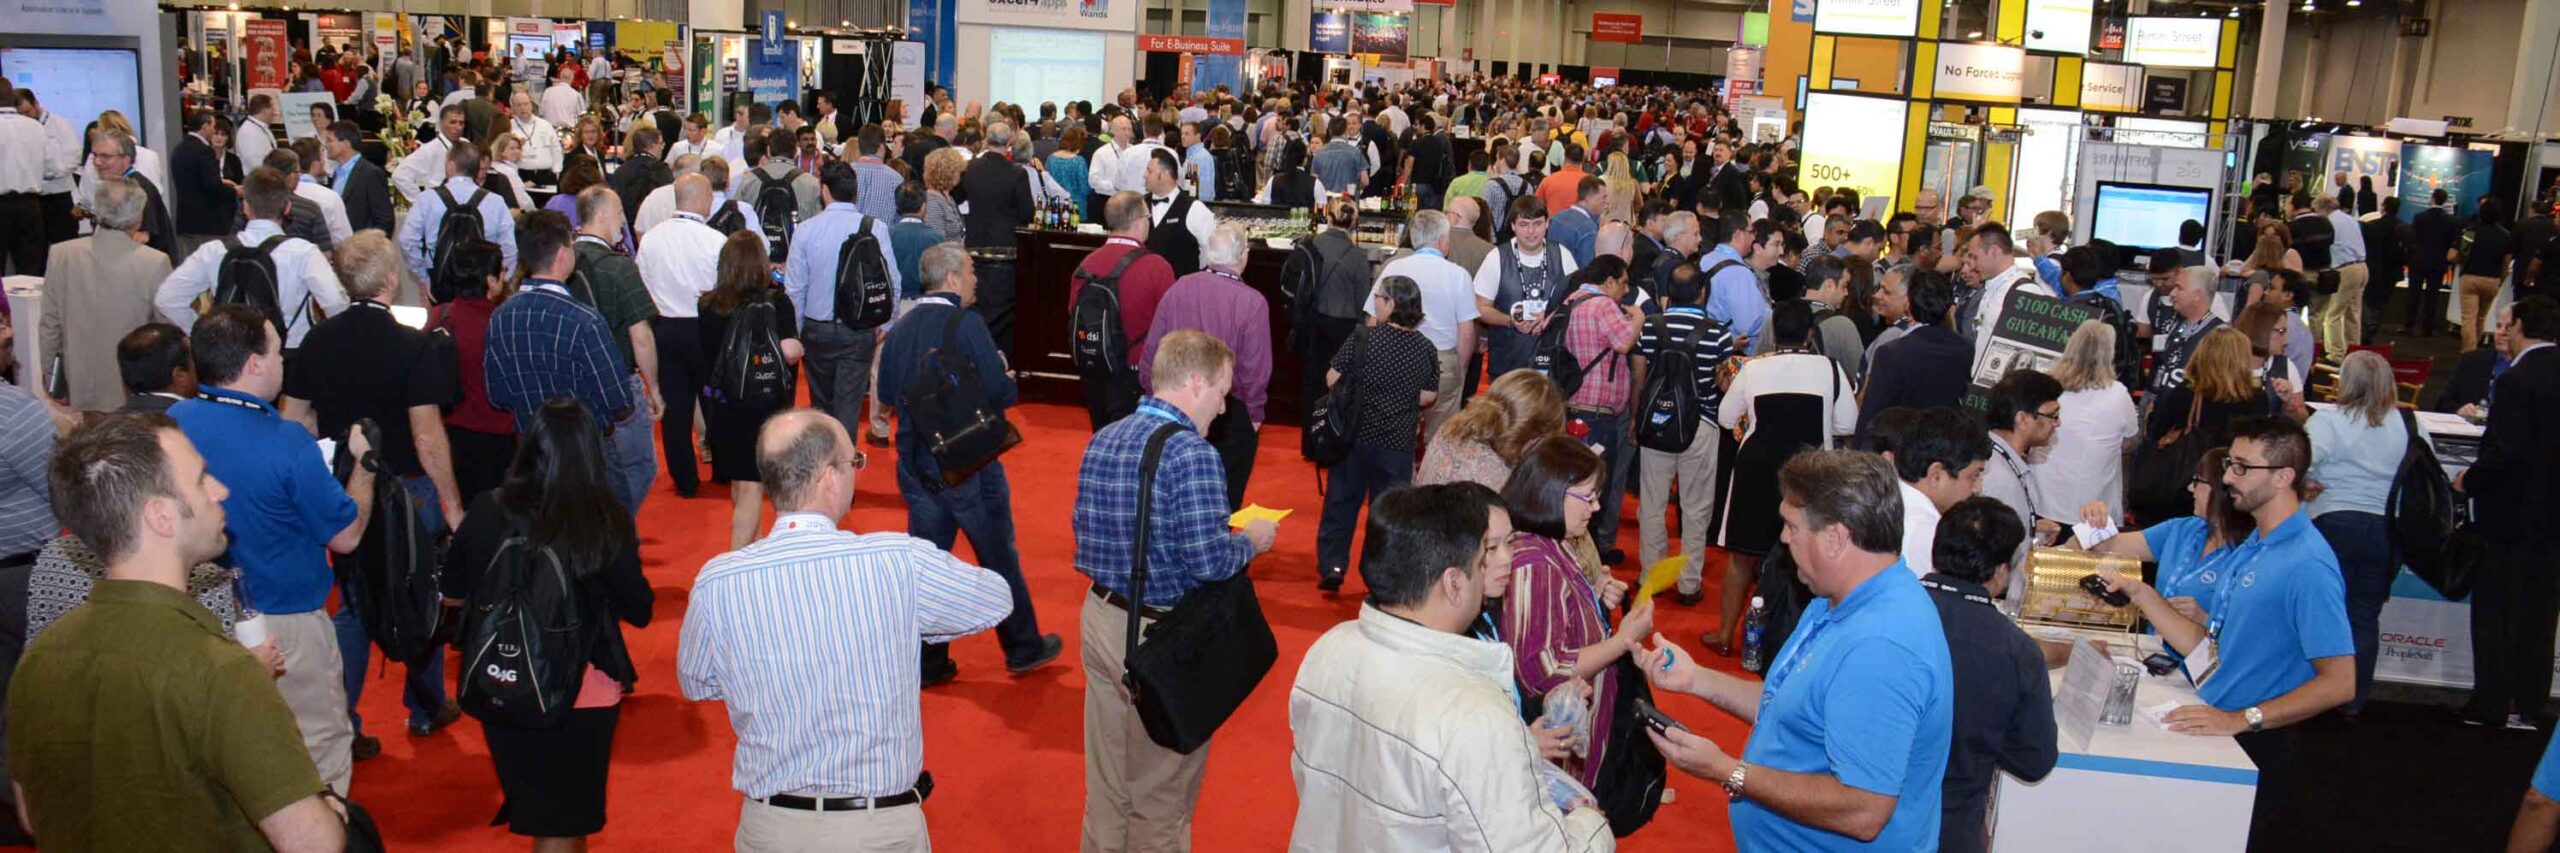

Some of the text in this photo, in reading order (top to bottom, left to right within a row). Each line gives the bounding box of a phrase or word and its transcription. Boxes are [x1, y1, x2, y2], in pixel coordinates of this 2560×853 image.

[1080, 10, 1109, 19] Wands
[1150, 38, 1231, 53] For E-Business Suite
[1944, 64, 1962, 77] No
[2087, 81, 2125, 94] Service
[1811, 163, 1852, 182] 500+
[2015, 295, 2089, 326] $100 CASH
[2005, 315, 2070, 345] GIVEAWA
[2380, 632, 2449, 648] ORACLE
[2383, 646, 2433, 662] PeopleSoft
